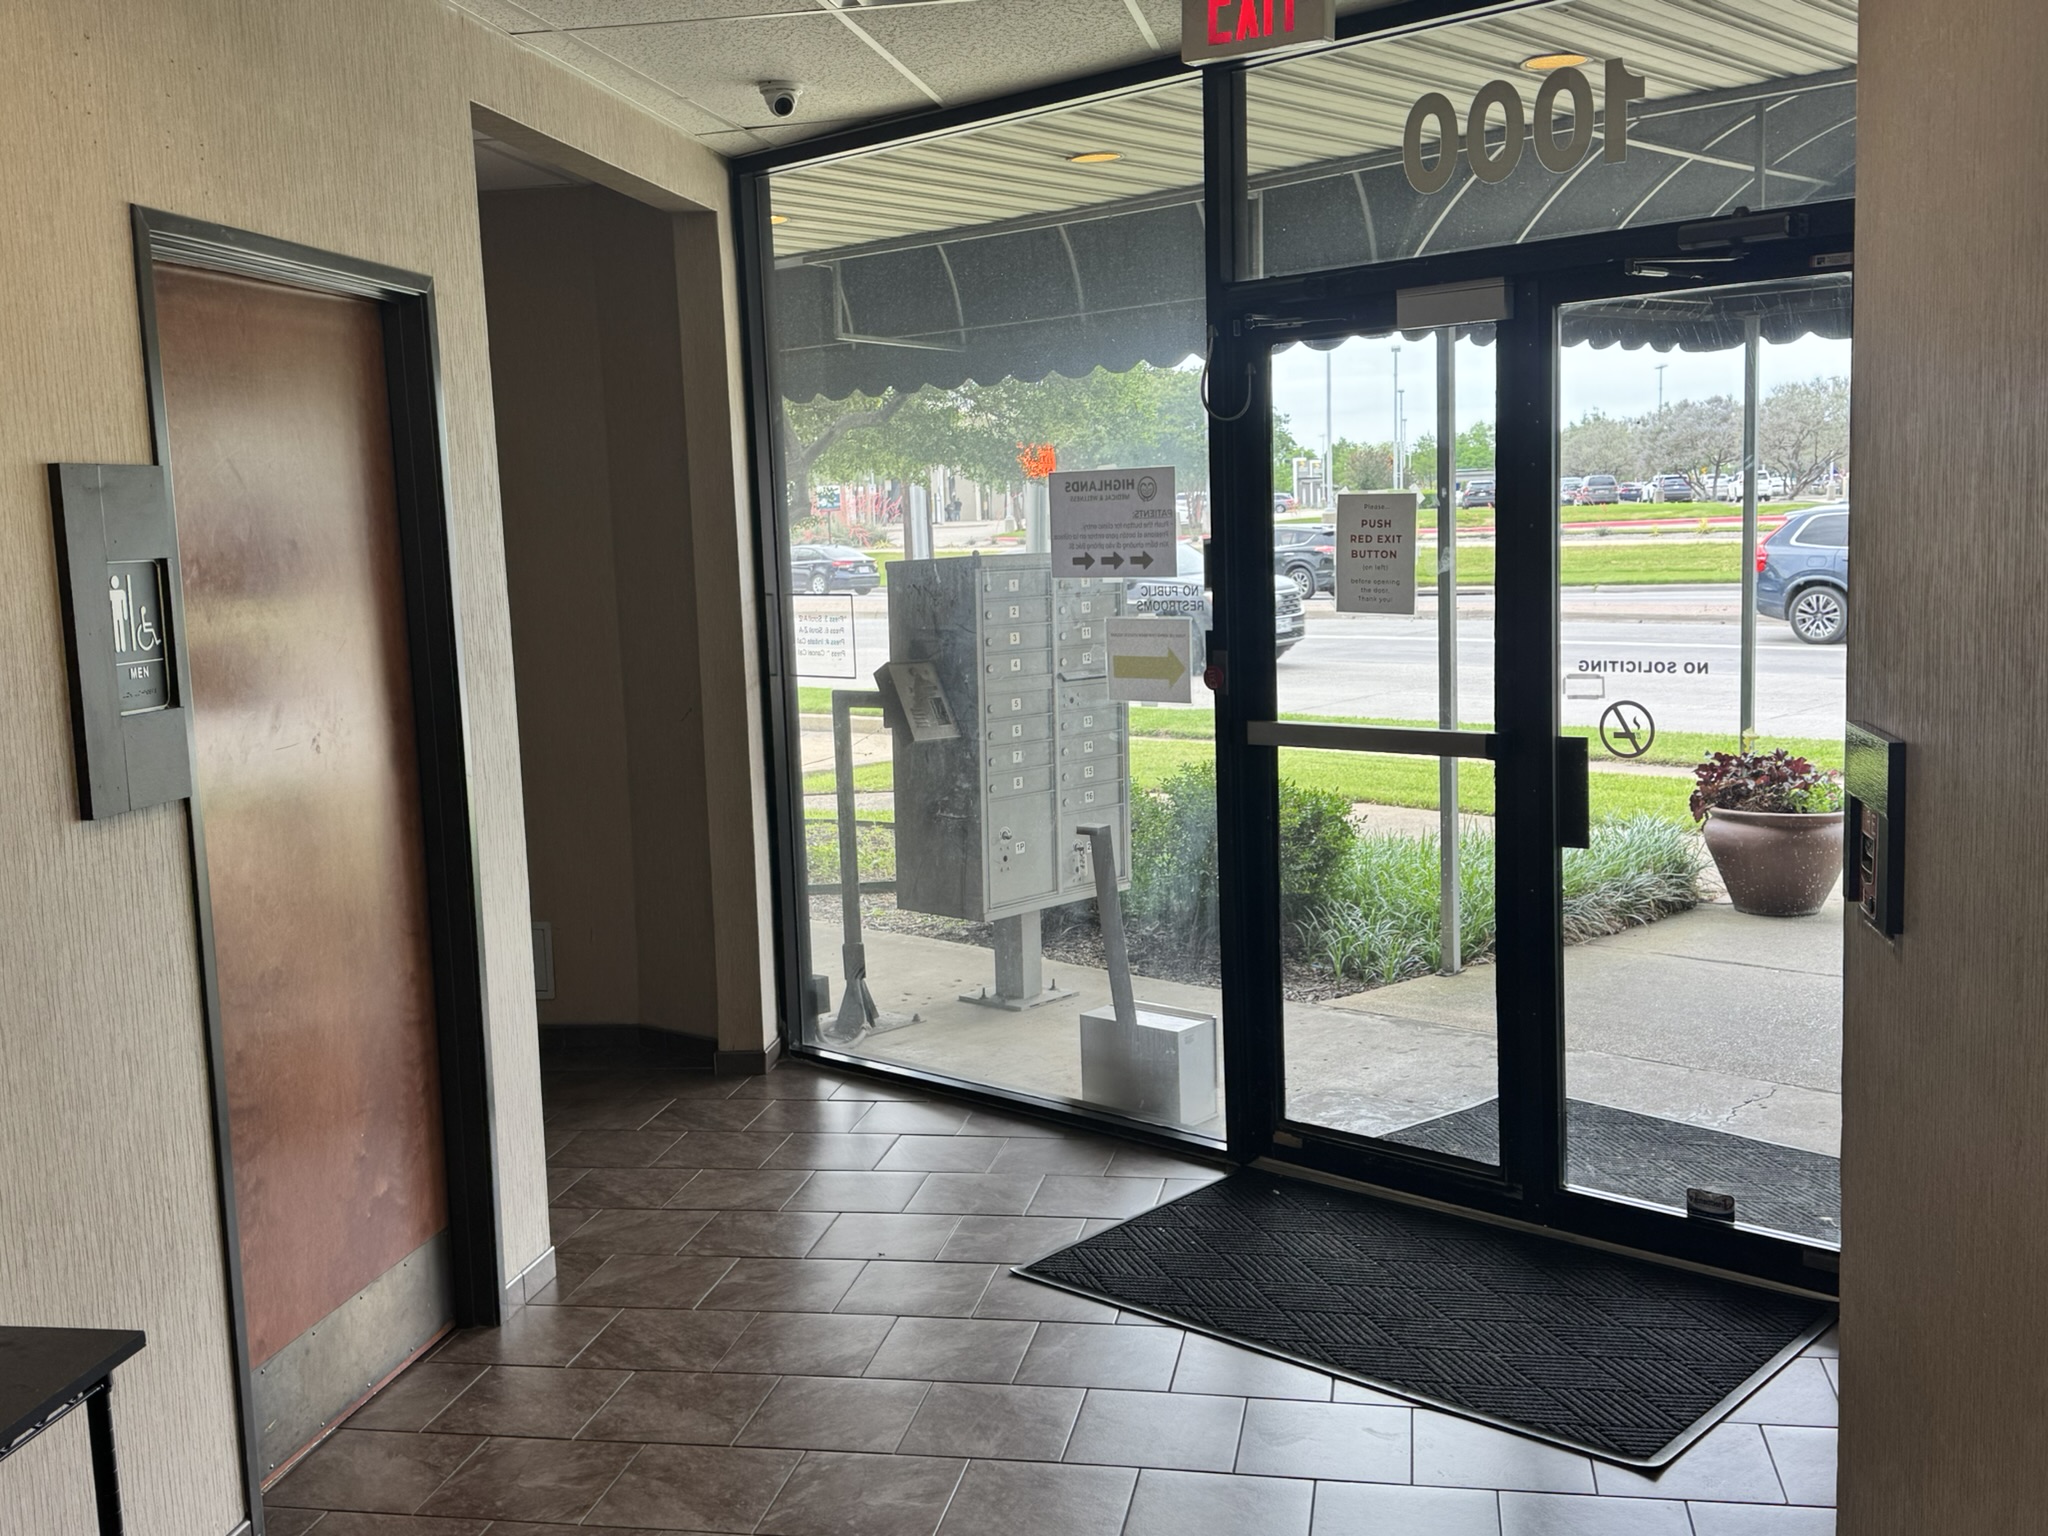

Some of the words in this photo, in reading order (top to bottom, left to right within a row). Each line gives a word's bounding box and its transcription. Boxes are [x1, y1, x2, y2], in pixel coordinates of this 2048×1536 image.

[1360, 519, 1392, 528] PUSH
[1350, 534, 1373, 544] RED
[1377, 534, 1403, 544] EXIT
[1351, 549, 1397, 559] BUTTON
[1083, 603, 1090, 611] 10
[130, 666, 150, 680] MEN
[1085, 717, 1092, 726] 13
[1085, 742, 1092, 750] 14
[1085, 767, 1092, 775] 15
[1086, 792, 1093, 800] 16
[1016, 843, 1024, 851] 1P
